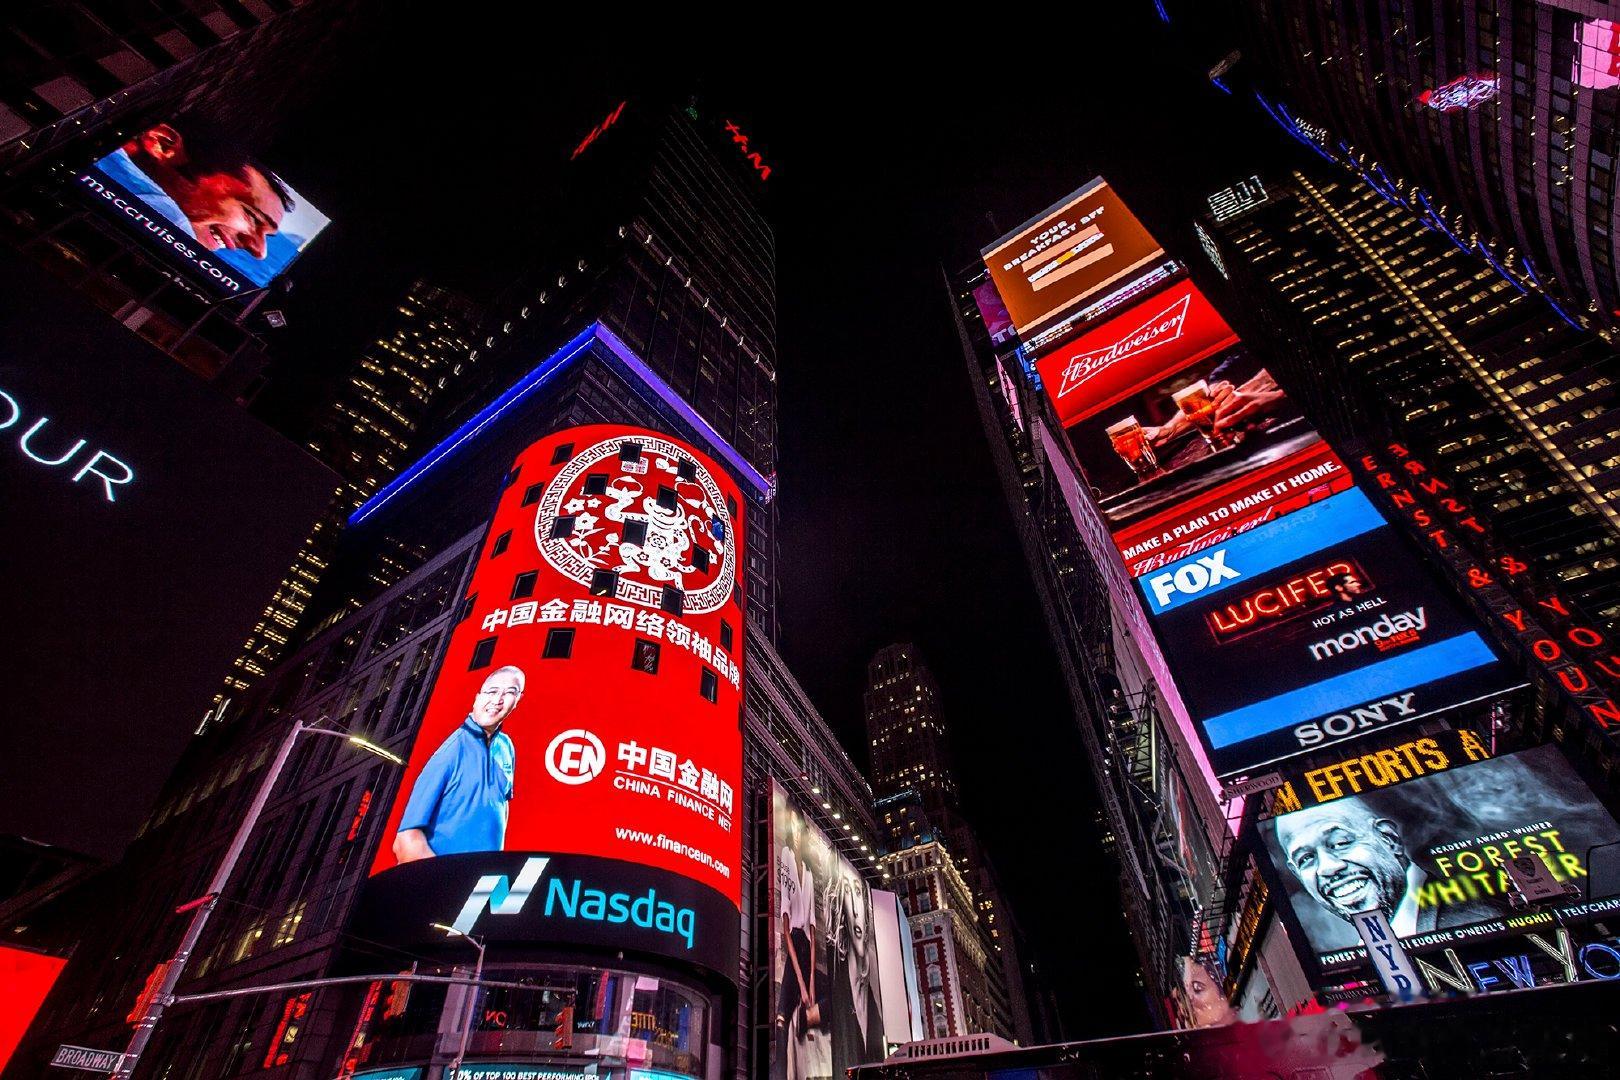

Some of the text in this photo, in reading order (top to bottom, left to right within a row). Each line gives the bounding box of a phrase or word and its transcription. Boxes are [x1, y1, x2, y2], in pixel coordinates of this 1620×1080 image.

[80, 174, 241, 292] msccruises.com
[1003, 222, 1077, 271] BREAKFAST
[1030, 220, 1068, 245] YOUR
[1062, 312, 1183, 383] Budweiser
[1122, 460, 1342, 561] MAKE A PLAN TO MAKE IT HOME.
[1361, 455, 1449, 549] ERNST
[1149, 549, 1242, 608] FOX
[1308, 606, 1427, 661] monday
[1312, 597, 1388, 629] HOT AS HELL
[481, 598, 741, 692] 中国金融网络领袖品牌
[1294, 692, 1416, 748] SONY
[617, 740, 734, 816] 中国金融网
[1304, 736, 1451, 802] EFFORTS
[613, 775, 733, 833] CHINA FINANCE NET
[1430, 839, 1474, 856] ACADEMY
[1512, 821, 1554, 836] WINNER
[544, 877, 696, 949] Nasdaq
[1411, 931, 1454, 948] EUGENE
[1320, 950, 1357, 966] FOREST
[55, 1049, 118, 1070] BROADWAY
[485, 1071, 501, 1080] TOP
[517, 1072, 538, 1080] BEST
